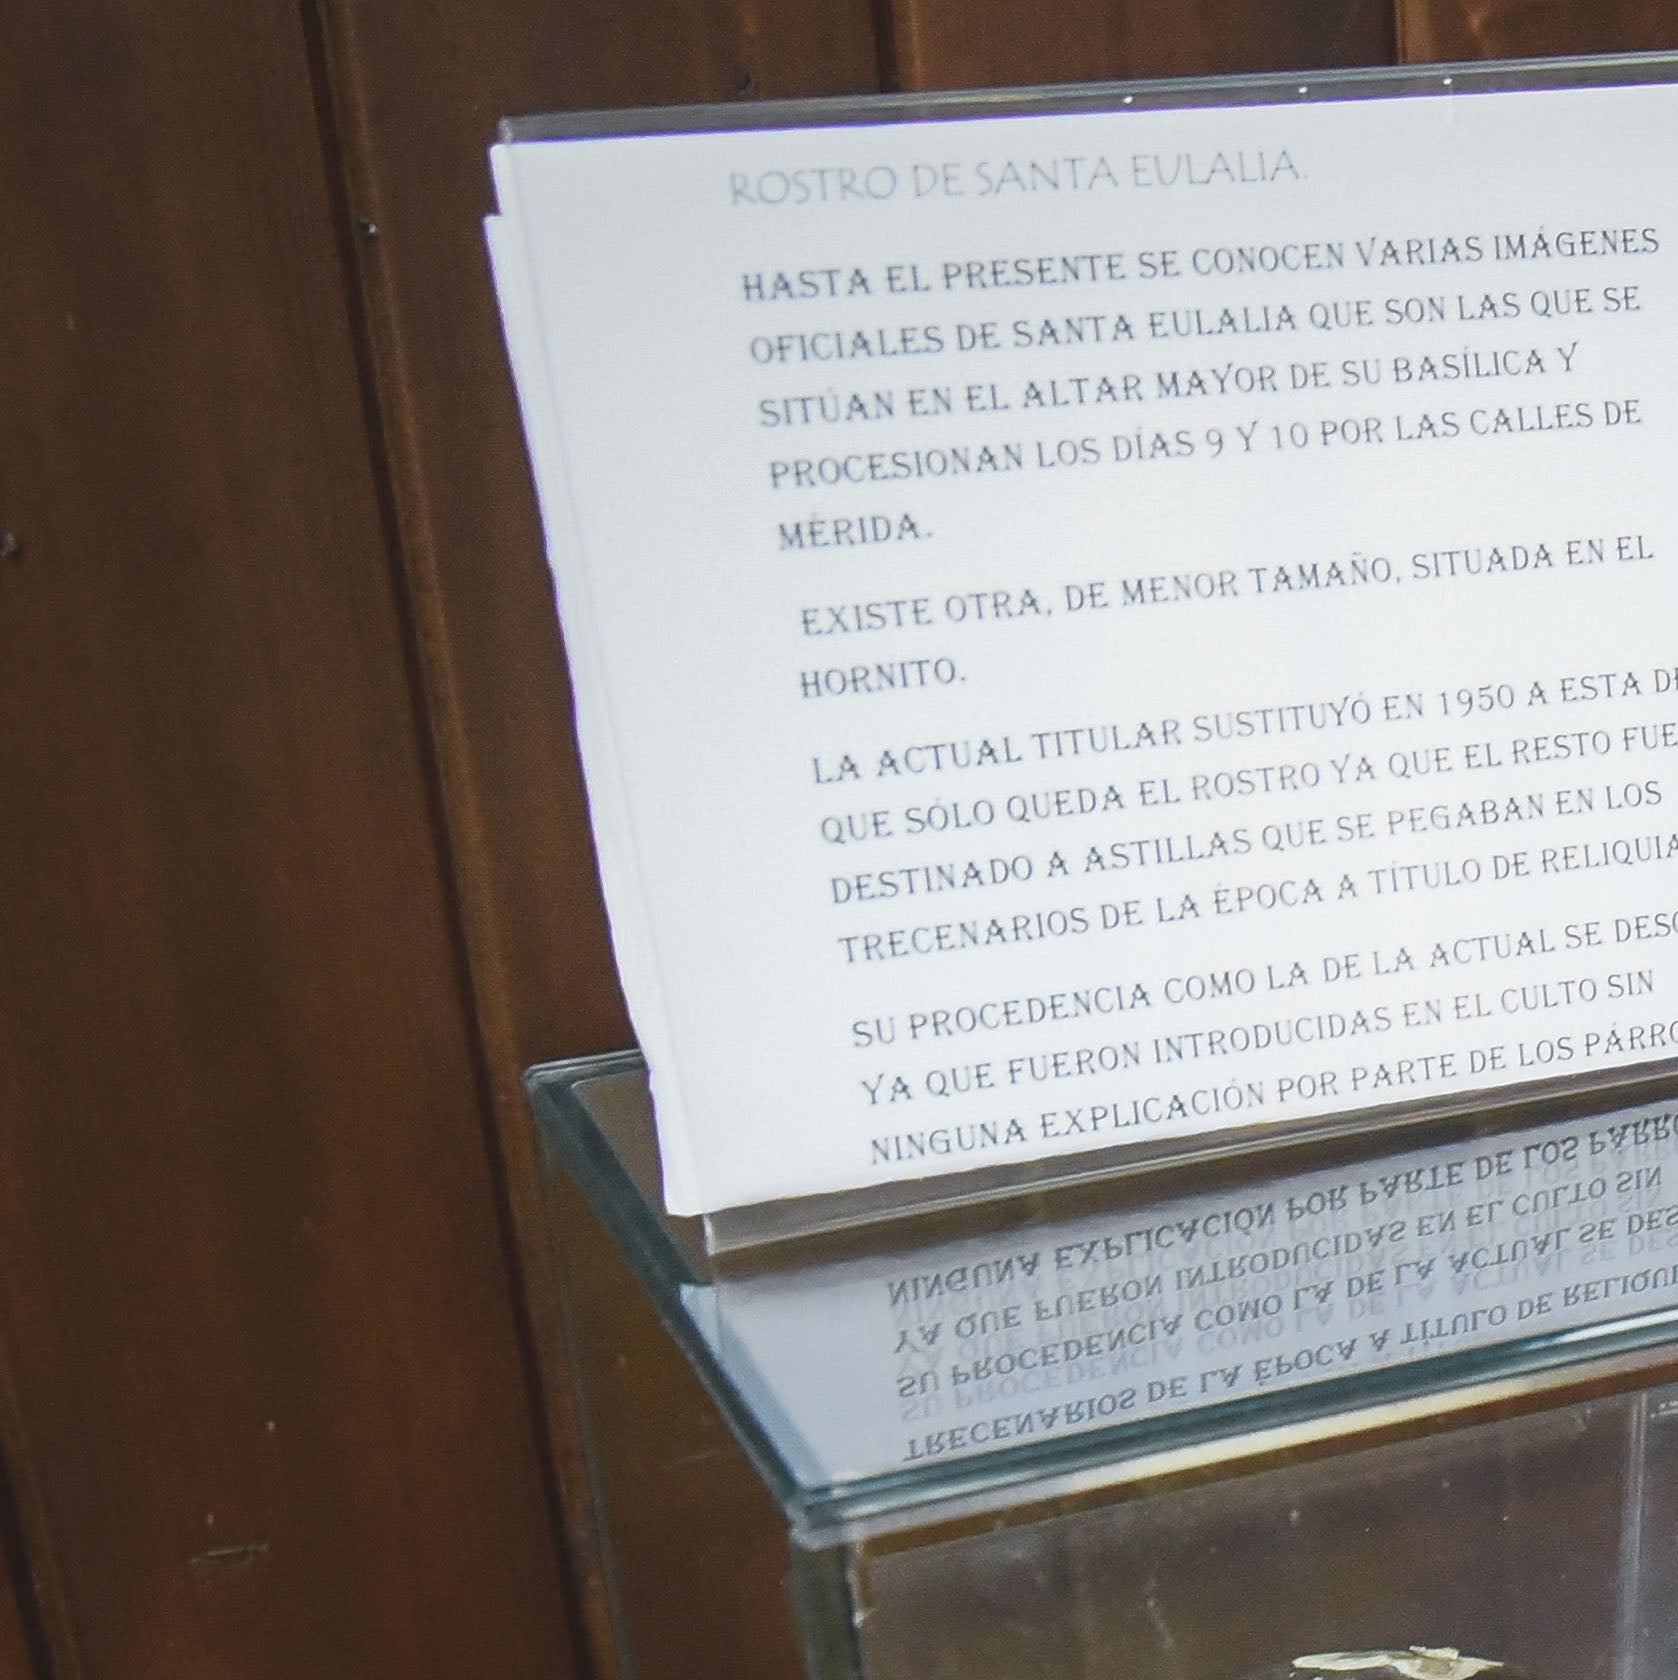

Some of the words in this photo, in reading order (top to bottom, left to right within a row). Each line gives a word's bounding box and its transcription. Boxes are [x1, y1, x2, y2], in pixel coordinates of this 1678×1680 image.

[728, 164, 899, 207] ROSTRO
[910, 161, 965, 200] DE
[974, 155, 1121, 198] SANTA
[742, 266, 873, 302] HASTA
[884, 263, 932, 294] EL
[942, 252, 1128, 292] PRESENTE
[1137, 249, 1182, 280] SE
[1190, 241, 1345, 277] CONOCEN
[1354, 235, 1484, 268] VARIAS
[1493, 225, 1660, 262] IMÁGENES
[748, 324, 946, 365] OFICIALES
[954, 321, 1002, 353] DE
[1012, 313, 1136, 349] SANTA
[1147, 303, 1299, 340] EULALIA
[1307, 298, 1375, 332] QUE
[1384, 295, 1446, 326] SON
[1456, 291, 1522, 322] LAS
[1529, 287, 1595, 319] QUE
[1602, 284, 1642, 314] SE
[758, 386, 895, 428] SITÚAN
[906, 385, 953, 418] EN
[964, 382, 1011, 414] EL
[1022, 373, 1145, 409] ALTAR
[1154, 361, 1279, 400] MAYOR
[1288, 361, 1332, 391] DE
[1340, 357, 1382, 388] SU
[1392, 345, 1548, 385] BASÍLICA
[1556, 340, 1579, 373] Y
[769, 442, 1024, 490] PROCESIONAN
[1034, 436, 1102, 470] LOS
[1111, 429, 1196, 463] DÍAS
[1204, 427, 1225, 459] 9
[1234, 419, 1258, 454] Y
[1272, 421, 1310, 451] 10
[1319, 416, 1385, 448] POR
[1394, 410, 1461, 443] LAS
[1468, 401, 1594, 437] CALLES
[1602, 398, 1644, 427] DE
[800, 596, 935, 637] EXISTE
[944, 587, 1053, 623] OTRA,
[1064, 580, 1110, 613] DE
[1120, 569, 1240, 607] MENOR
[1246, 552, 1402, 595] TAMAÑO,
[1411, 542, 1555, 581] SITUADA
[1565, 537, 1605, 567] EN
[1615, 534, 1655, 563] EL
[800, 656, 967, 699] HORNITO.
[811, 753, 863, 785] LA
[876, 735, 1025, 778] ACTUAL
[1029, 718, 1183, 760] TITULAR
[1192, 693, 1372, 743] SUSTITUYÓ
[1382, 692, 1424, 722] EN
[1439, 683, 1516, 718] 1950
[1526, 680, 1550, 708] A
[1559, 671, 1644, 704] ESTA
[819, 809, 895, 846] QUE
[904, 797, 996, 835] SÓLO
[1005, 783, 1127, 825] QUEDA
[1138, 777, 1183, 808] EL
[1191, 761, 1321, 802] ROSTRO
[1328, 752, 1377, 785] YA
[1387, 746, 1454, 780] QUE
[1463, 741, 1504, 770] EL
[1511, 729, 1612, 766] RESTO
[830, 854, 1035, 905] DESTINADO
[1046, 849, 1071, 879] A
[1083, 827, 1253, 874] ASTILLAS
[1260, 818, 1328, 853] QUE
[1336, 812, 1376, 843] SE
[1387, 792, 1545, 836] PEGABAN
[1554, 786, 1595, 816] EN
[1605, 779, 1663, 811] LOS
[836, 906, 1090, 964] TRECENARIOS
[1099, 898, 1145, 931] DE
[1155, 893, 1202, 924] LA
[1212, 877, 1325, 916] ÉPOCA
[1337, 873, 1359, 901] A
[1366, 858, 1482, 896] TÍTULO
[1492, 850, 1532, 881] DE
[851, 1016, 896, 1049] SU
[908, 981, 1153, 1041] PROCEDENCIA
[1163, 967, 1257, 1005] COMO
[1266, 961, 1310, 991] LA
[1322, 952, 1363, 984] DE
[1372, 946, 1416, 976] LA
[1429, 927, 1557, 969] ACTUAL
[1563, 920, 1604, 950] SE
[860, 1071, 914, 1107] YA
[924, 1061, 997, 1099] QUE
[1007, 1040, 1141, 1086] FUERON
[1153, 1005, 1393, 1065] INTRODUCIDAS
[1402, 998, 1443, 1028] EN
[1453, 992, 1493, 1021] EL
[1499, 977, 1598, 1014] CULTO
[1606, 968, 1654, 1000] SIN
[870, 1117, 1028, 1166] NINGUNA
[1040, 1078, 1265, 1140] EXPLICACIÓN
[1277, 1070, 1340, 1104] POR
[1351, 1052, 1459, 1093] PARTE
[1469, 1044, 1508, 1075] DE
[1518, 1035, 1575, 1068] LOS
